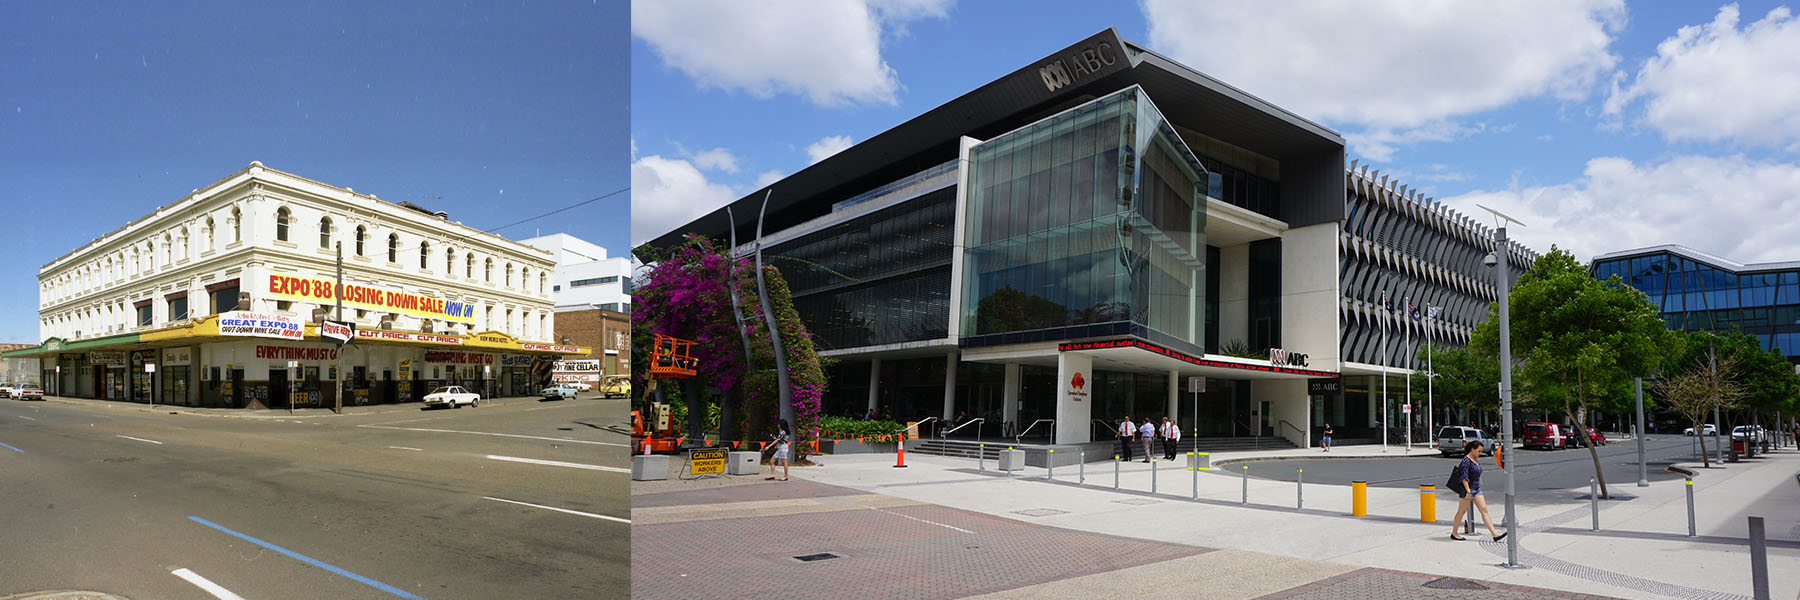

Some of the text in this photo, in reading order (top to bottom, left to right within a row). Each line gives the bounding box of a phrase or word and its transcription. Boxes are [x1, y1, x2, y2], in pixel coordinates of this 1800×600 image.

[1072, 42, 1116, 79] ABC
[270, 275, 310, 296] EXPO
[334, 283, 384, 306] CLOSING
[386, 291, 418, 310] DOWN
[420, 296, 444, 314] SALE
[444, 300, 463, 317] NOW
[464, 304, 474, 318] ON
[260, 320, 287, 329] EXPO
[324, 323, 340, 334] DRIVE
[359, 330, 380, 338] CUT
[306, 347, 328, 360] MUST
[485, 354, 493, 364] GO
[1287, 352, 1309, 367] ABC
[289, 392, 308, 404] BEER
